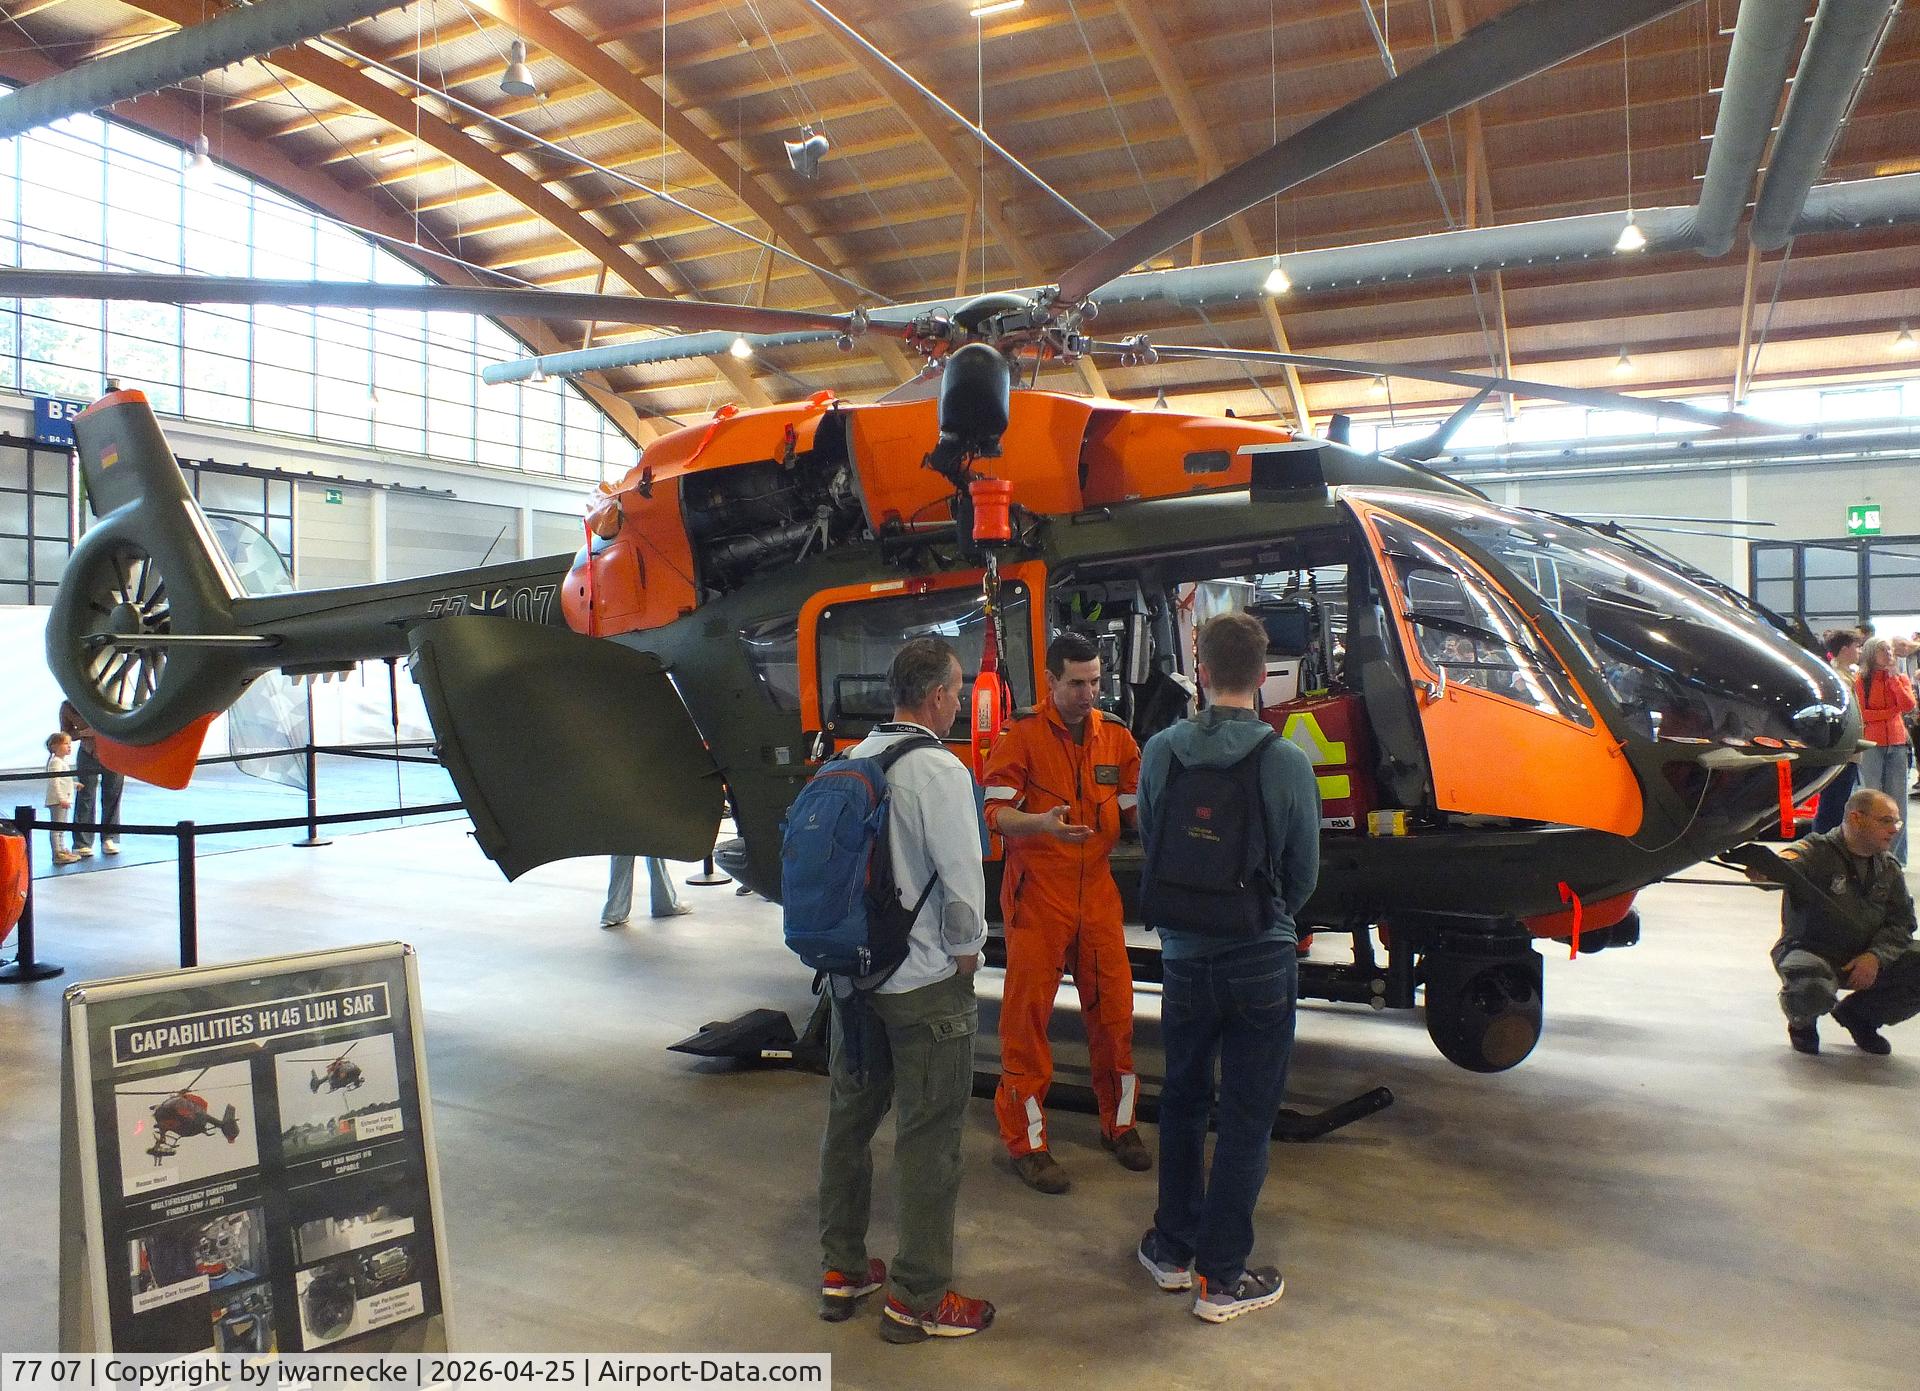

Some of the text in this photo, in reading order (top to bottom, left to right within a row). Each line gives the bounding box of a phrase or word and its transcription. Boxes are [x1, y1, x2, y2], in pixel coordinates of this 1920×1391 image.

[49, 401, 77, 422] B5
[428, 584, 557, 625] 77 07
[1331, 819, 1350, 827] PAX
[130, 994, 375, 1053] CAPABILITIES H145 LUH SAR
[166, 1204, 188, 1216] FINDER
